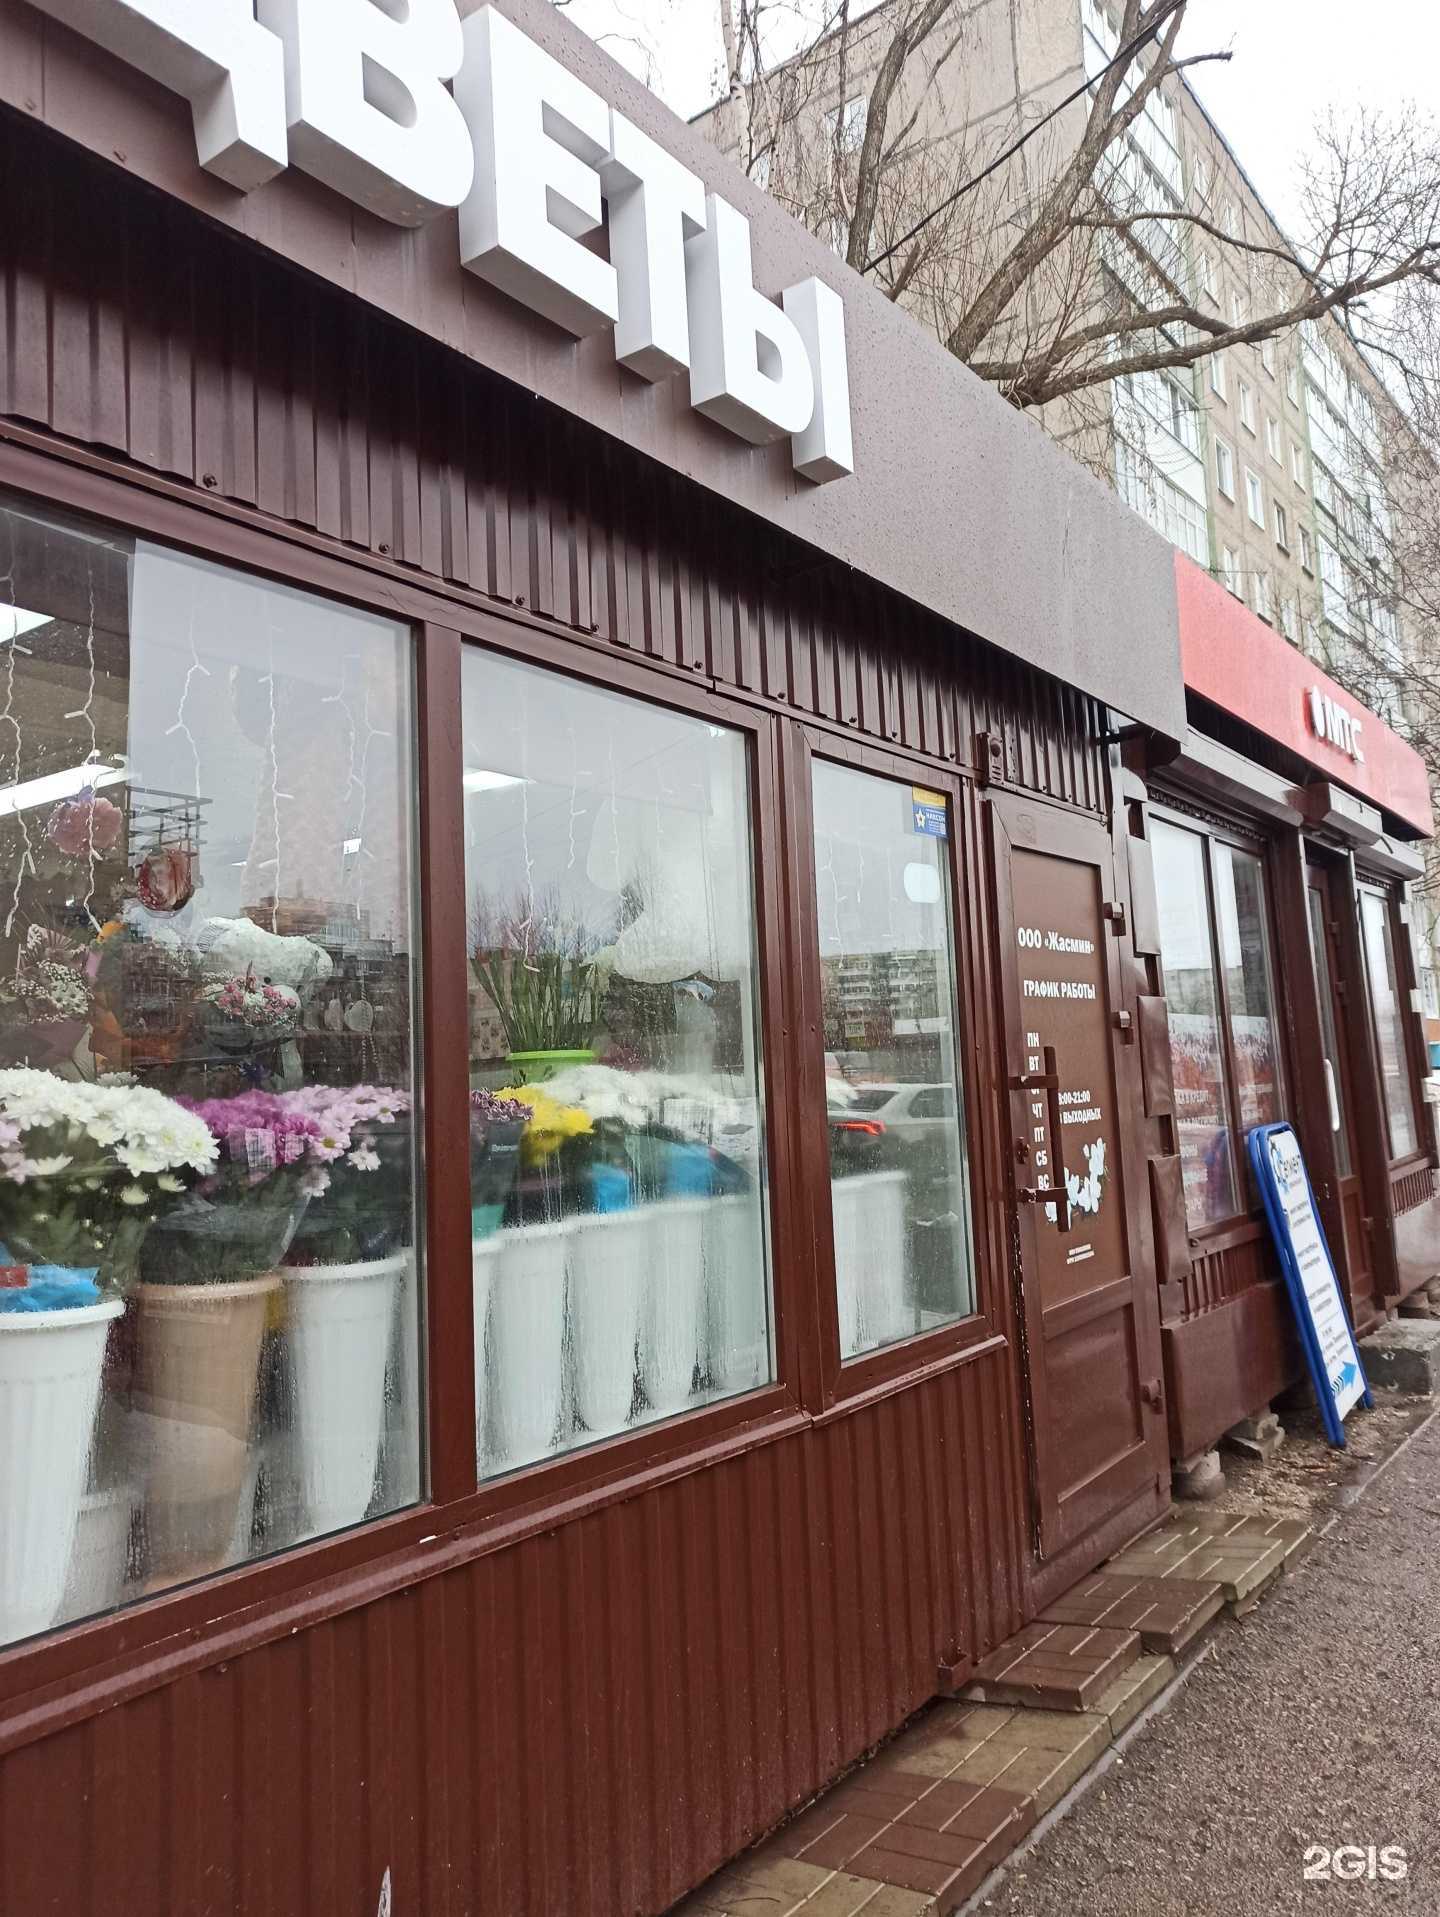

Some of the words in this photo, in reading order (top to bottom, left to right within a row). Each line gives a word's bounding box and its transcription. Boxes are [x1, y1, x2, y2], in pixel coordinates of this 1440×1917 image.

[1017, 927, 1042, 949] ООО
[1045, 930, 1095, 954] «Жасмин»
[1023, 979, 1060, 998] ГРАФИК
[1061, 982, 1096, 1000] РАБОТЫ
[1026, 1032, 1040, 1048] ПН
[1028, 1055, 1040, 1072] ВТ
[1031, 1102, 1043, 1119] ЧТ
[1063, 1107, 1102, 1124] ВЫХОДНЫХ
[1033, 1126, 1045, 1143] ПТ
[1035, 1149, 1048, 1167] СБ
[1037, 1173, 1050, 1191] ВС
